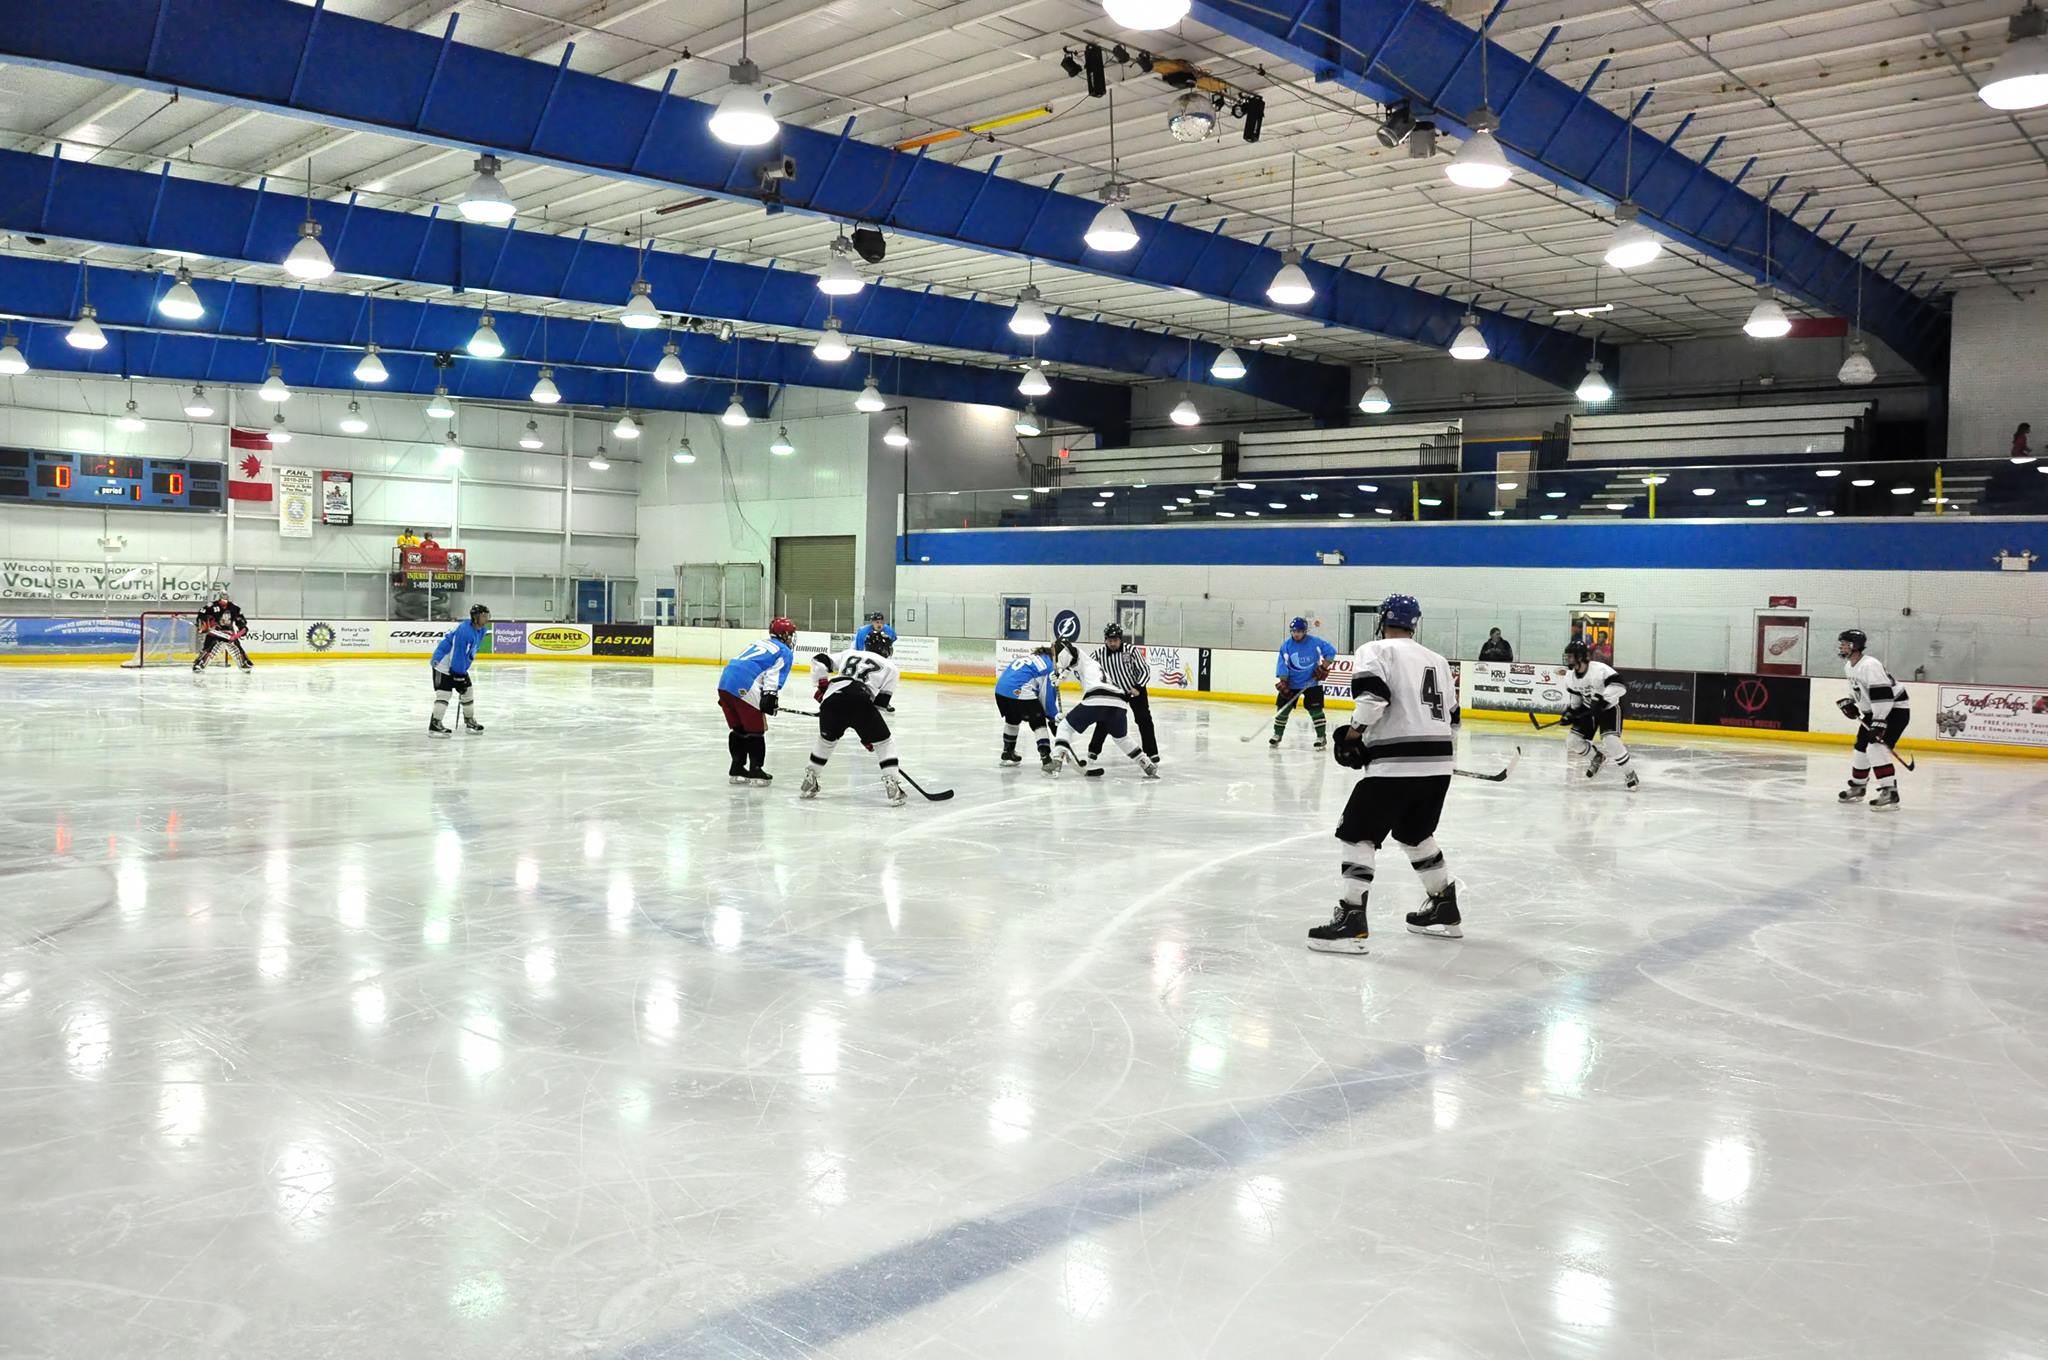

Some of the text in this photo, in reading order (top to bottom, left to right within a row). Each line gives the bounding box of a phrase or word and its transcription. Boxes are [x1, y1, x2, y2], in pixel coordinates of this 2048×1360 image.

[56, 465, 71, 488] 0
[169, 473, 183, 495] 0
[101, 485, 141, 500] period 1
[66, 566, 80, 574] TO
[107, 567, 136, 575] HOM
[4, 573, 231, 591] VOLUSIA YOUTH HOCKEY
[497, 635, 522, 643] Resort
[534, 632, 583, 640] OCEAN DECK
[594, 636, 652, 645] EASTON
[1149, 647, 1180, 658] WALK
[1166, 658, 1180, 669] ME
[1420, 666, 1446, 722] 4
